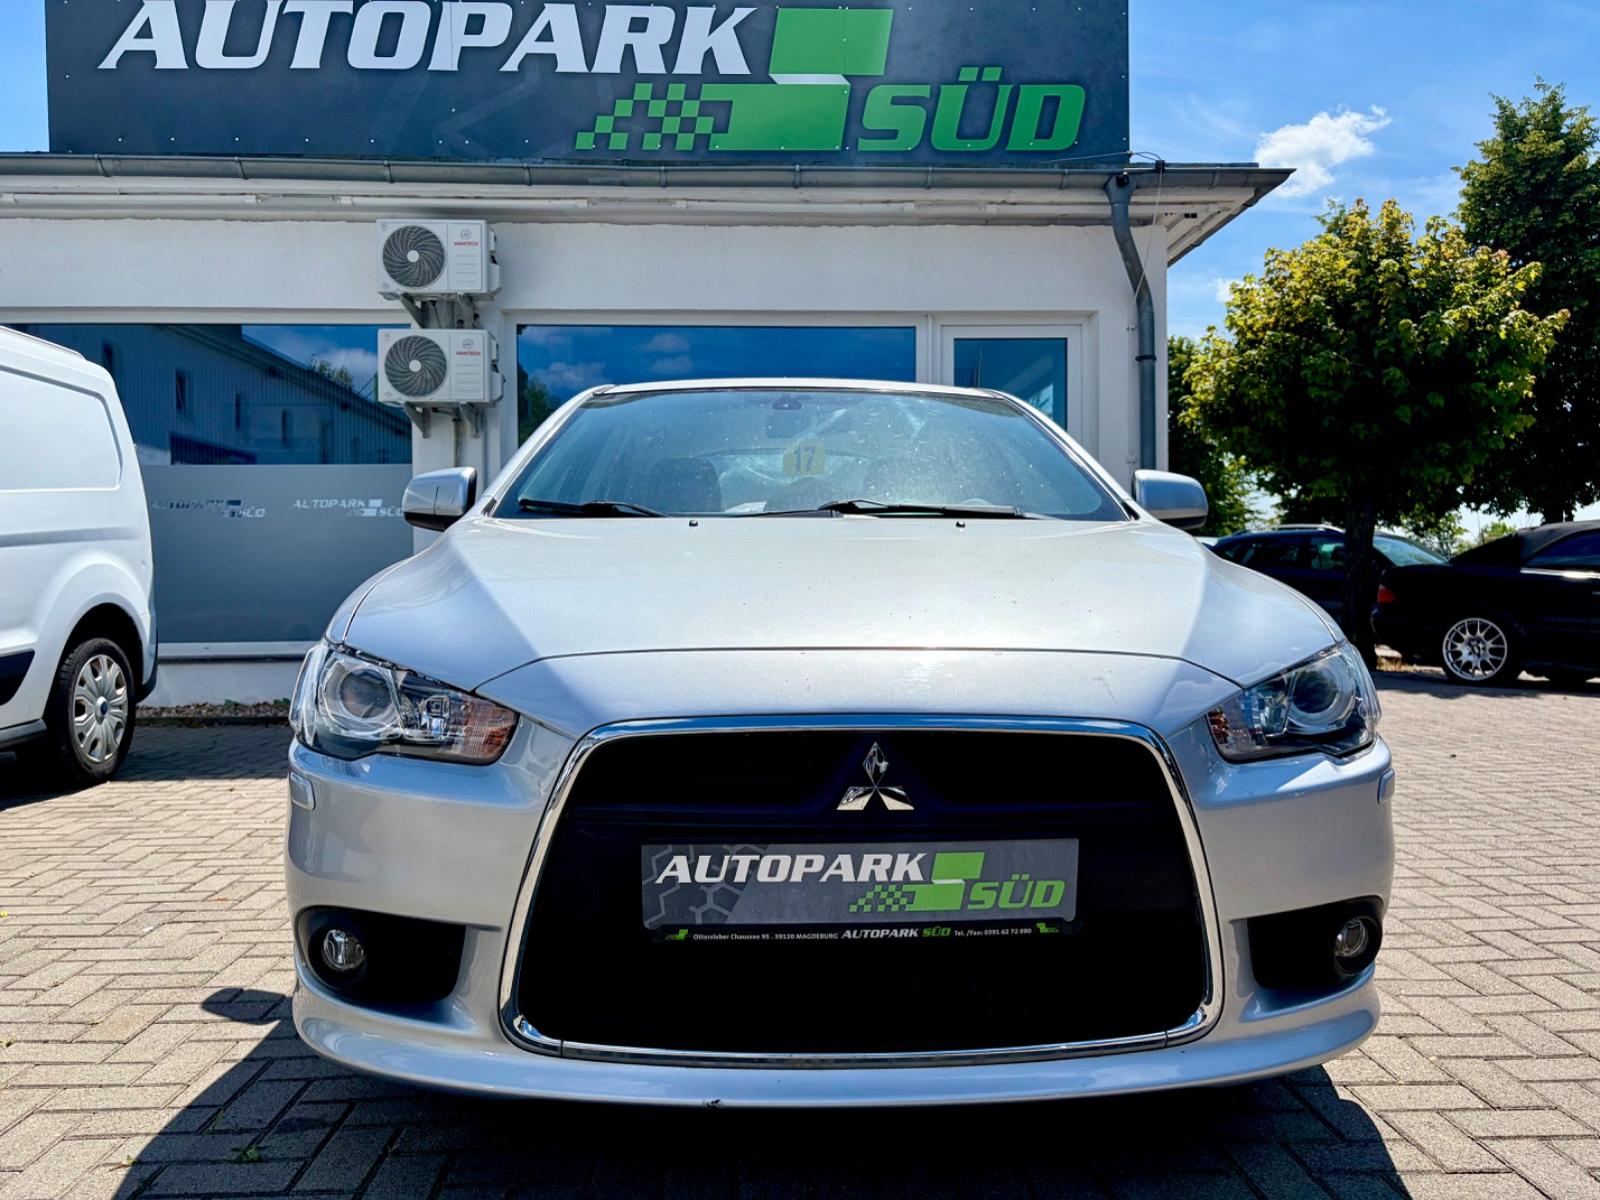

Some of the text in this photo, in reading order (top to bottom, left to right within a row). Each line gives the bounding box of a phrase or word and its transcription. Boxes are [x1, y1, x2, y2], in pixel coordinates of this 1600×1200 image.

[98, 0, 757, 76] AUTOPARK
[857, 66, 1086, 152] SÜD
[793, 446, 816, 472] 17
[655, 853, 927, 884] AUTOPARK
[967, 873, 1066, 910] SÜD
[796, 932, 839, 940] MAGDEBURG
[841, 928, 919, 939] AUTOPARK
[921, 925, 952, 938] SÜD
